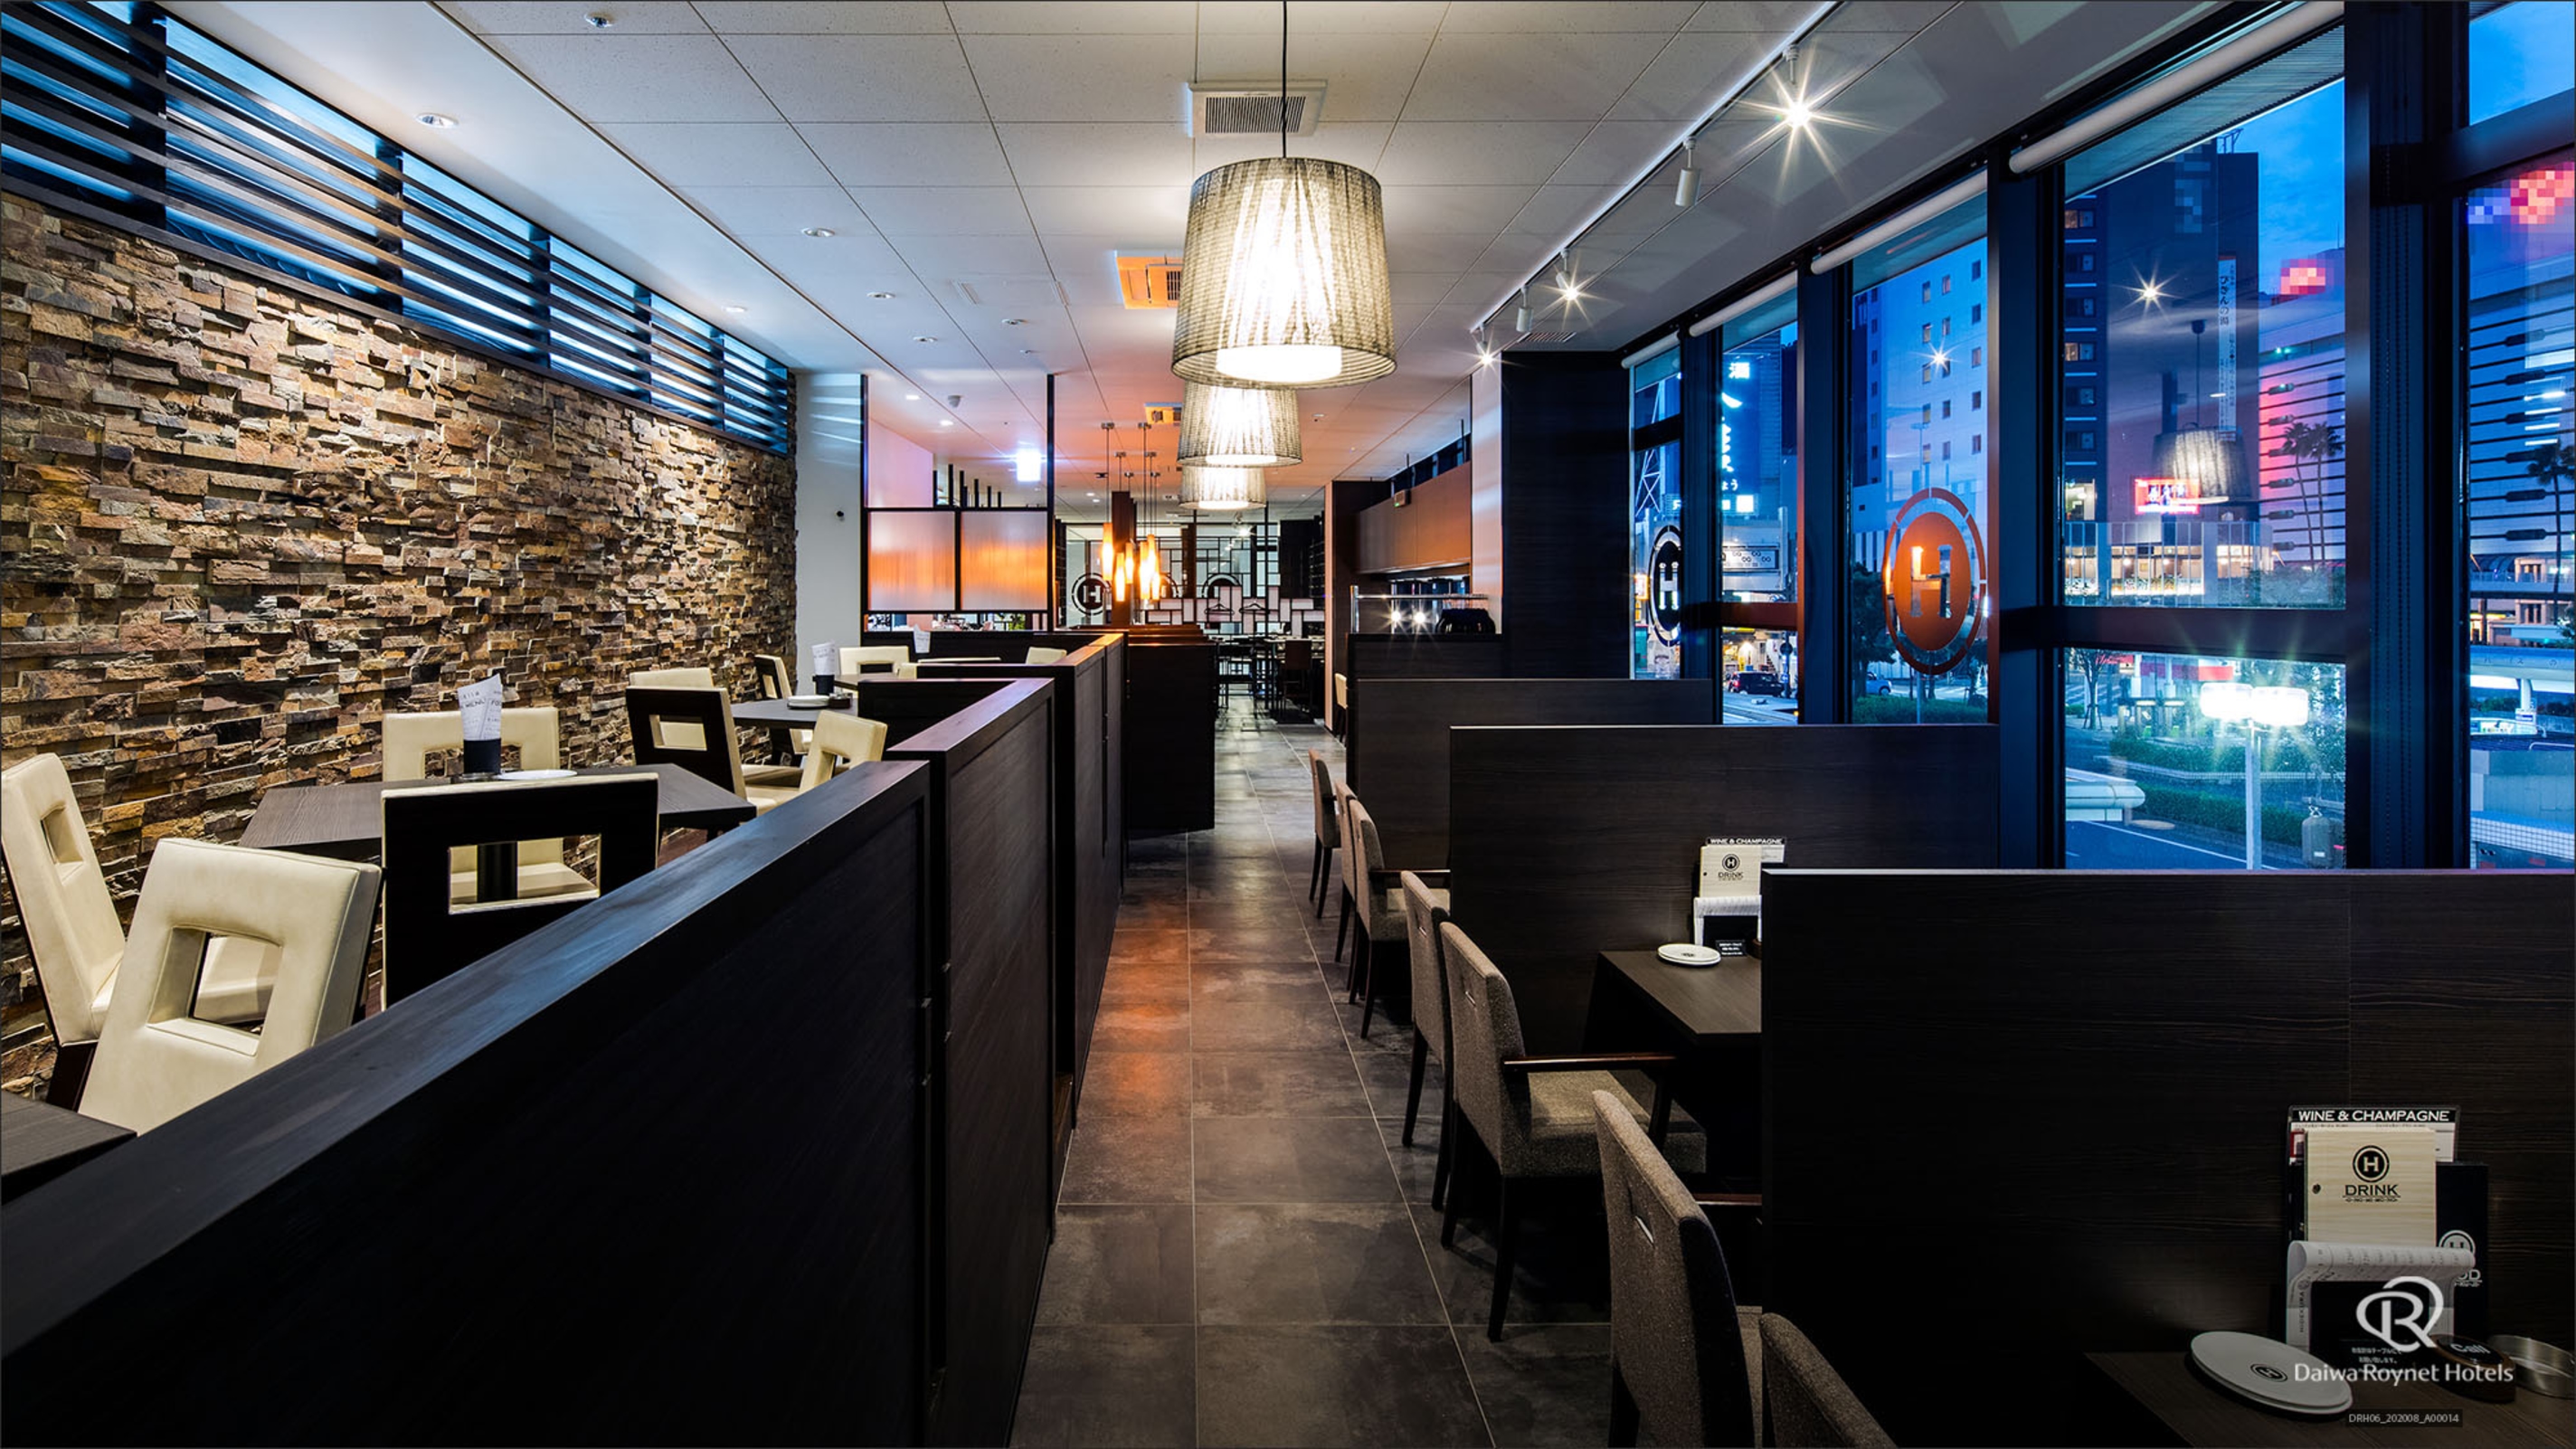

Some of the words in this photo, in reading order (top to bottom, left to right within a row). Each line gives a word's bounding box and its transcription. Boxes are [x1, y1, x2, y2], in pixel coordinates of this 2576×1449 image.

[1659, 563, 1680, 611] H
[1909, 545, 1952, 619] H
[1082, 585, 1102, 603] H
[2298, 1110, 2335, 1122] WINE
[2337, 1110, 2349, 1122] &
[2352, 1110, 2450, 1122] CHAMPAGNE
[2363, 1155, 2380, 1173] H
[2344, 1184, 2400, 1196] DRINK
